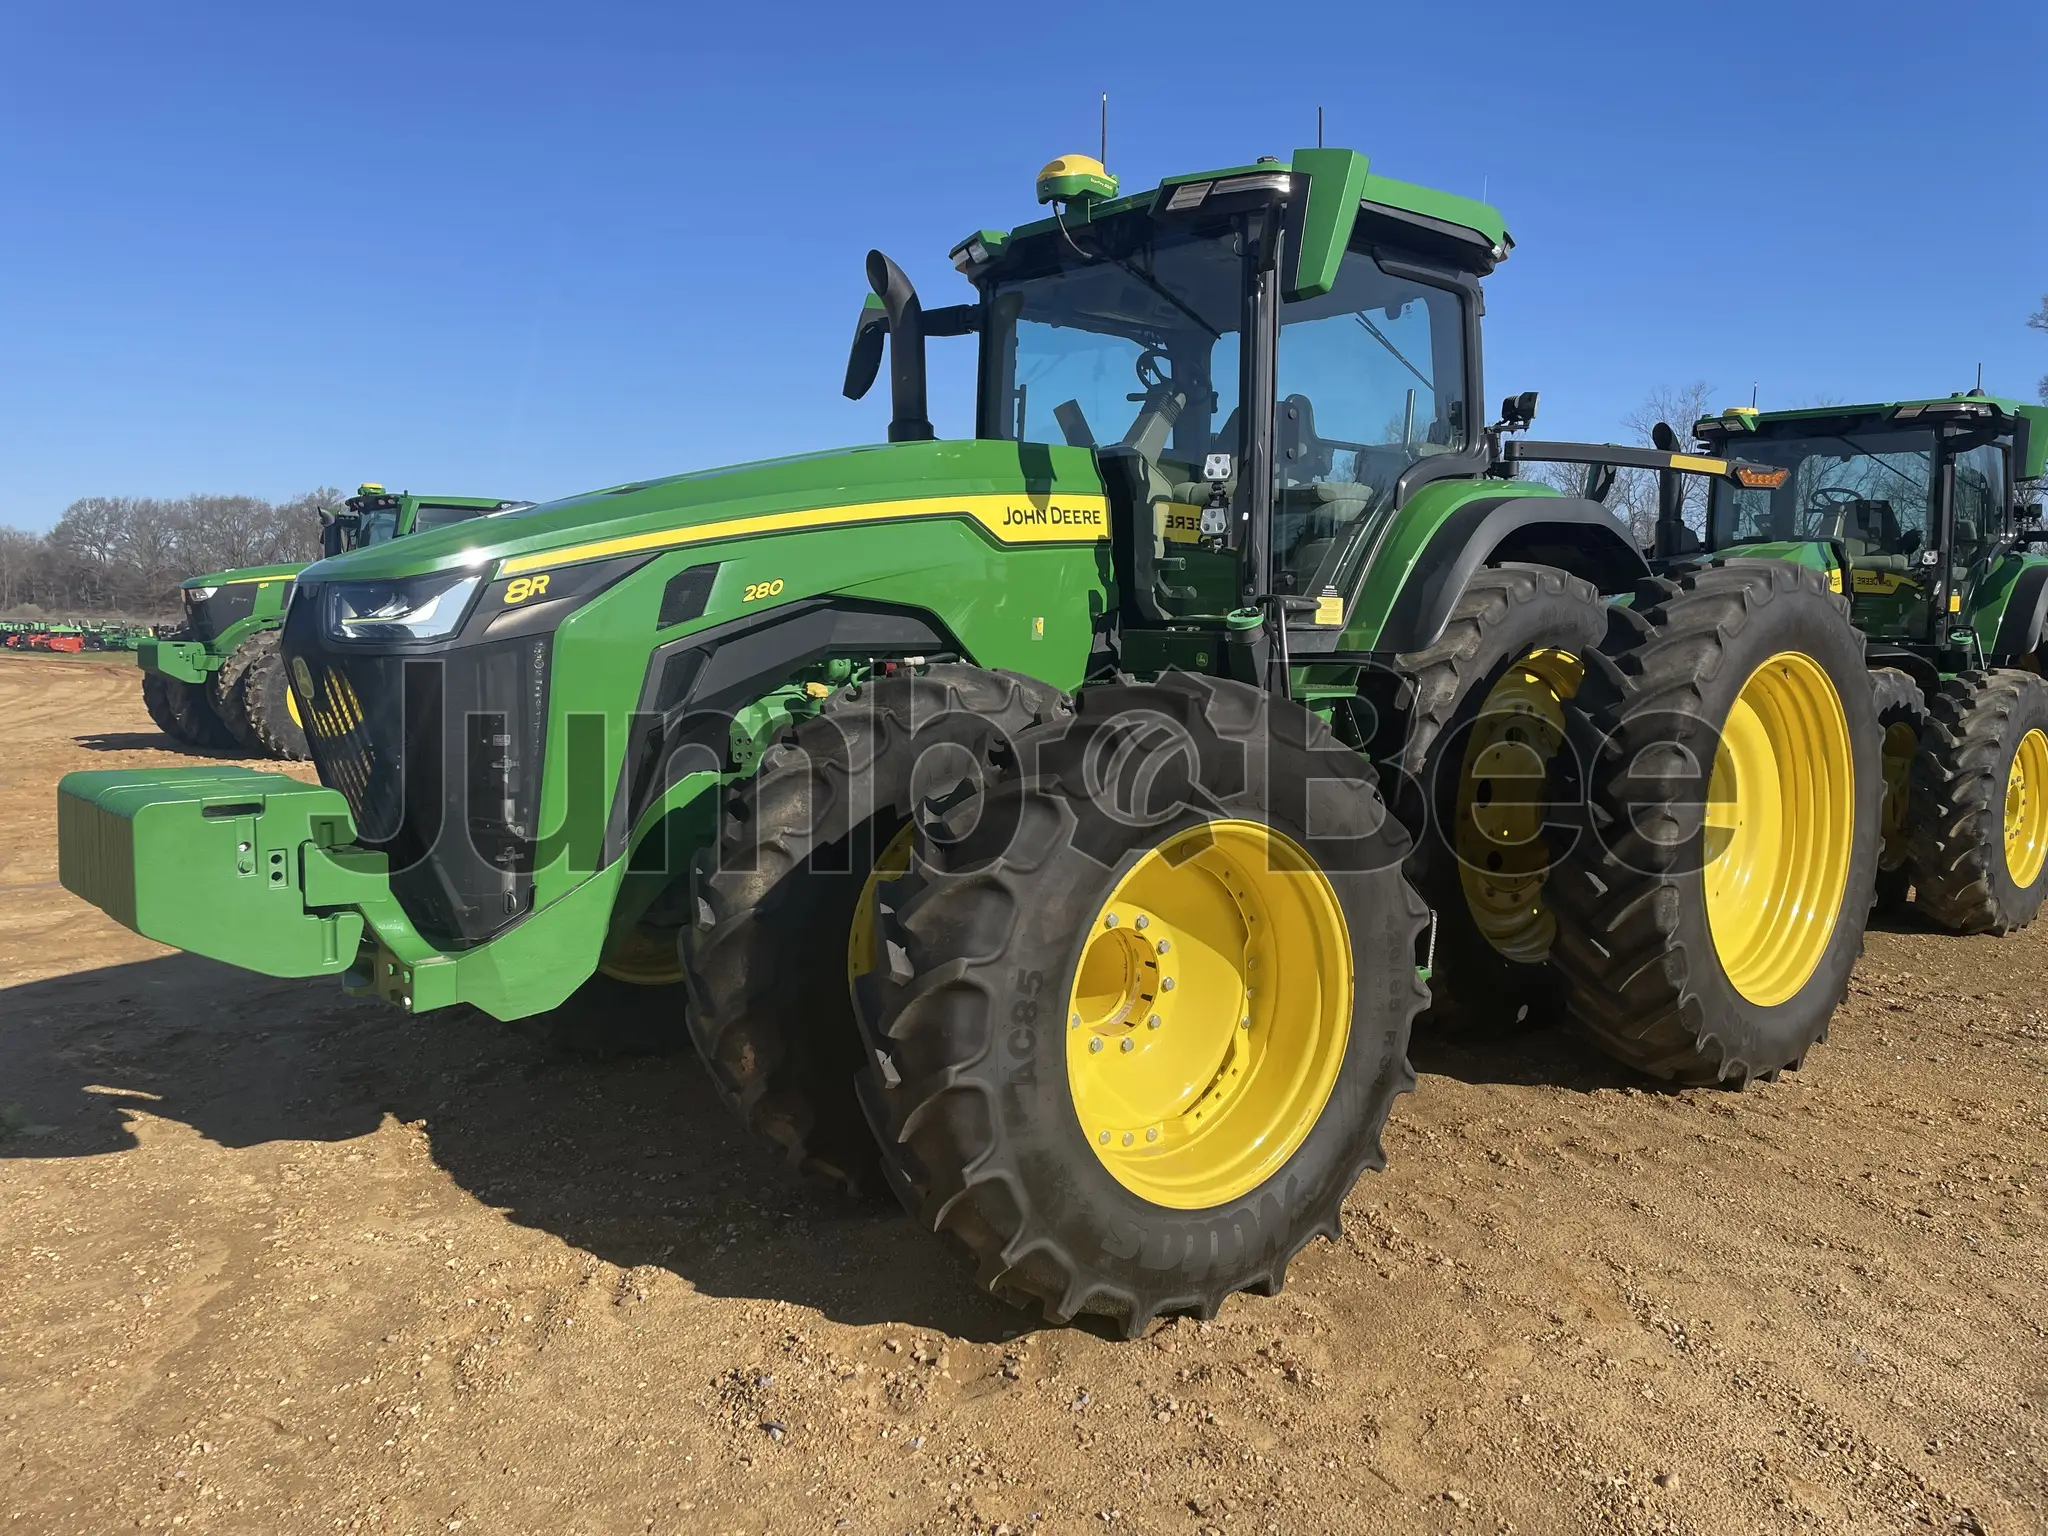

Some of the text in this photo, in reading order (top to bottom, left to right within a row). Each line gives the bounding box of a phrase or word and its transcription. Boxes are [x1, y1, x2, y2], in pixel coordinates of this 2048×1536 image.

[503, 575, 550, 604] 8R
[742, 578, 785, 603] 280
[1006, 967, 1044, 1085] AC85
